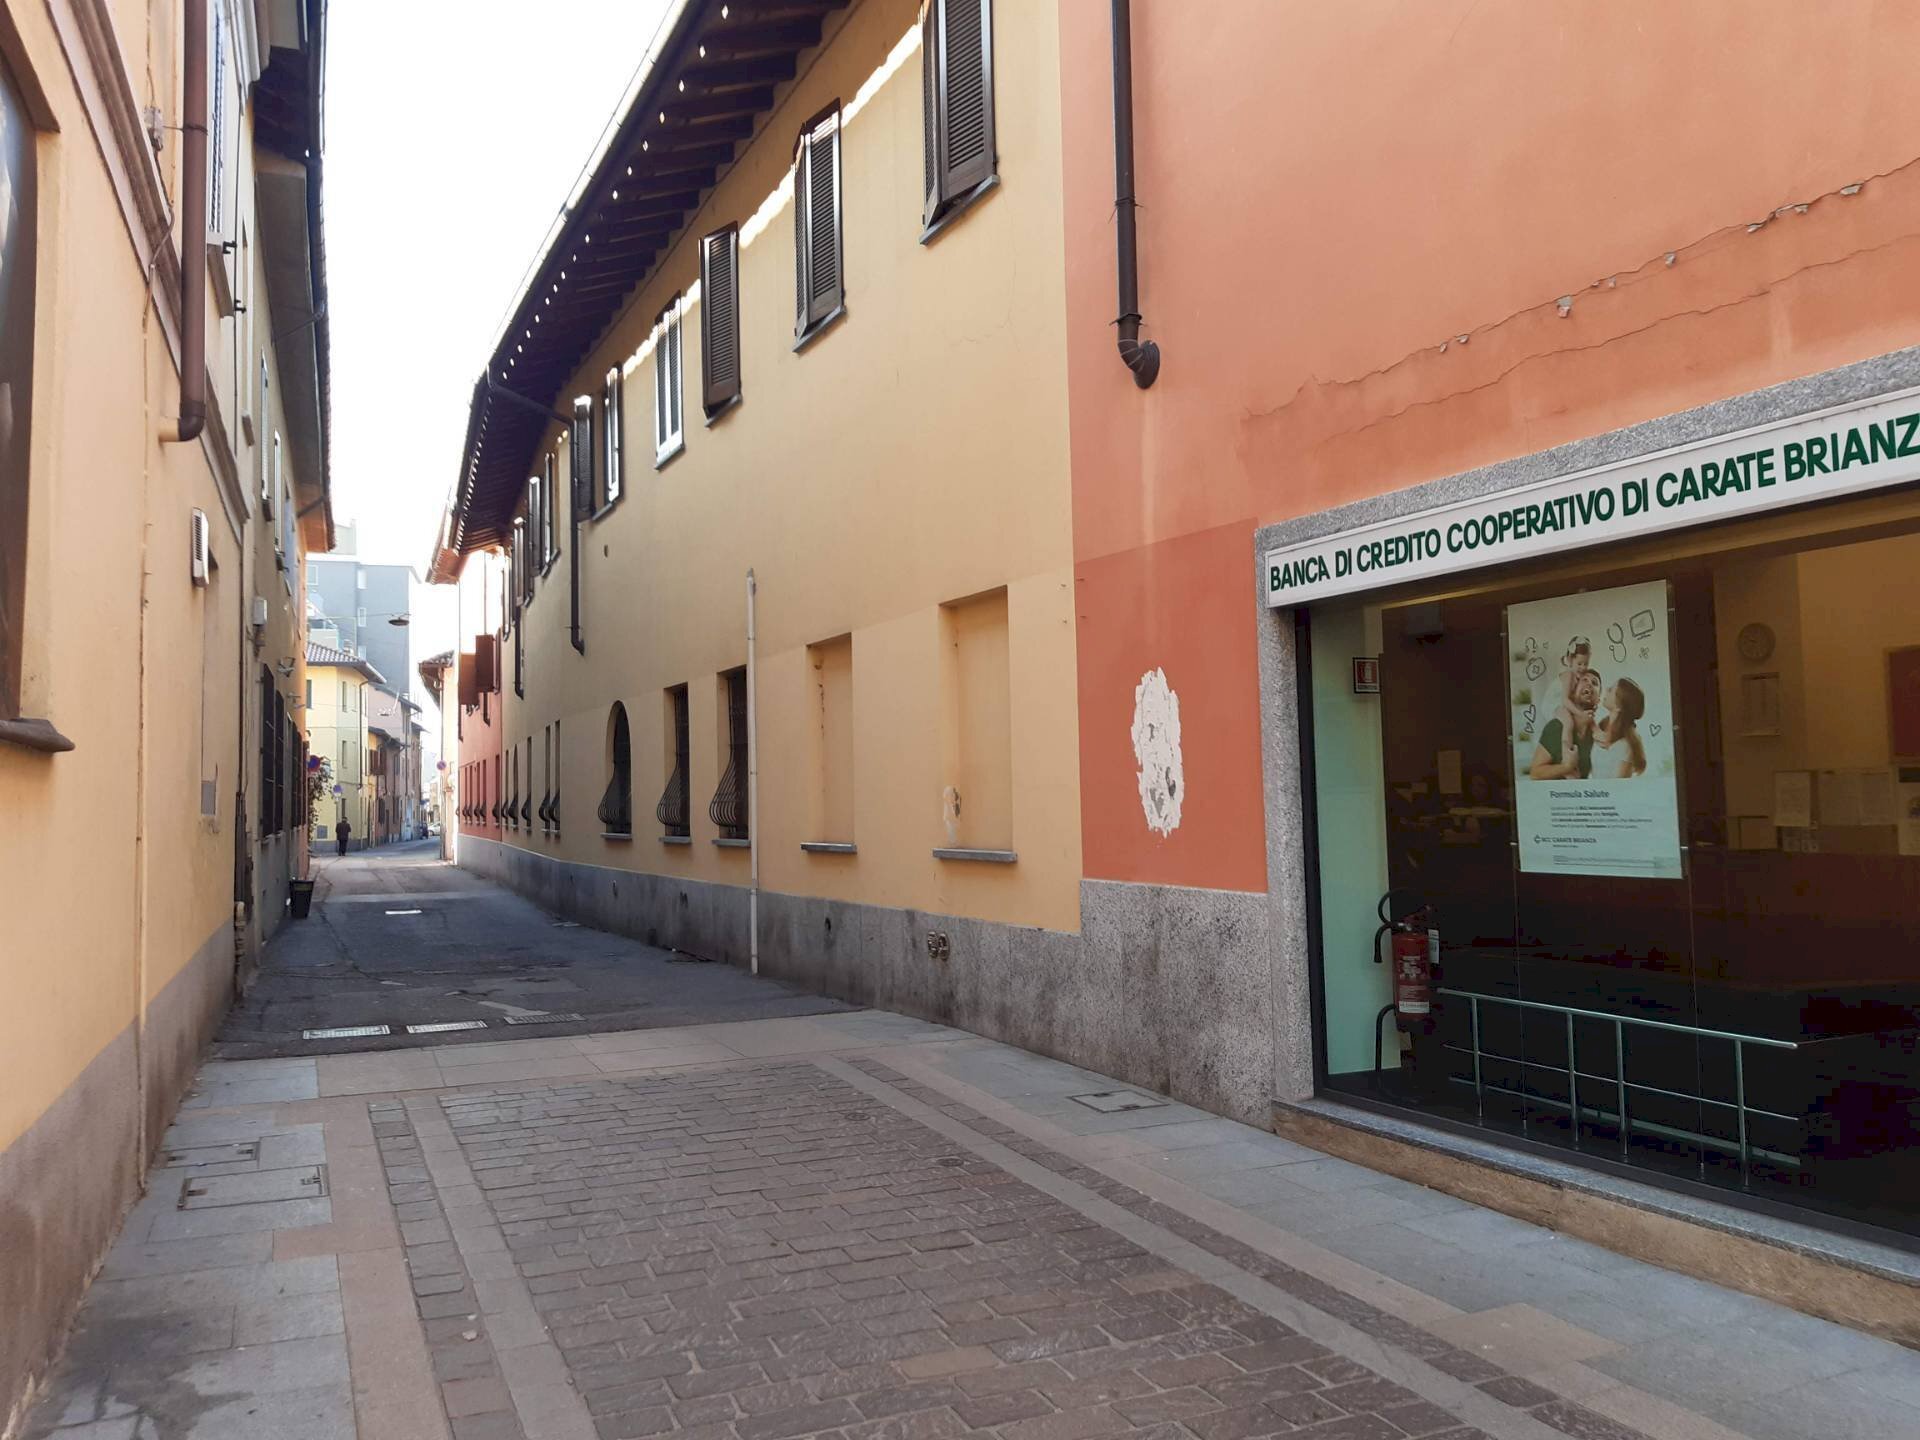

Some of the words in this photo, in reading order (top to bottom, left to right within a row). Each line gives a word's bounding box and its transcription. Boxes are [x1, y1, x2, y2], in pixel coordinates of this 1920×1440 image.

[1270, 555, 1331, 592] BANCA
[1335, 548, 1352, 578] DI
[1356, 529, 1441, 573] CREDITO
[1446, 488, 1615, 553] COOPERATIVO
[1622, 480, 1649, 517] DI
[1655, 448, 1777, 508] CARATE
[1783, 412, 1920, 482] BRIANZ
[1549, 790, 1582, 798] Formula
[1583, 790, 1609, 798] Salute
